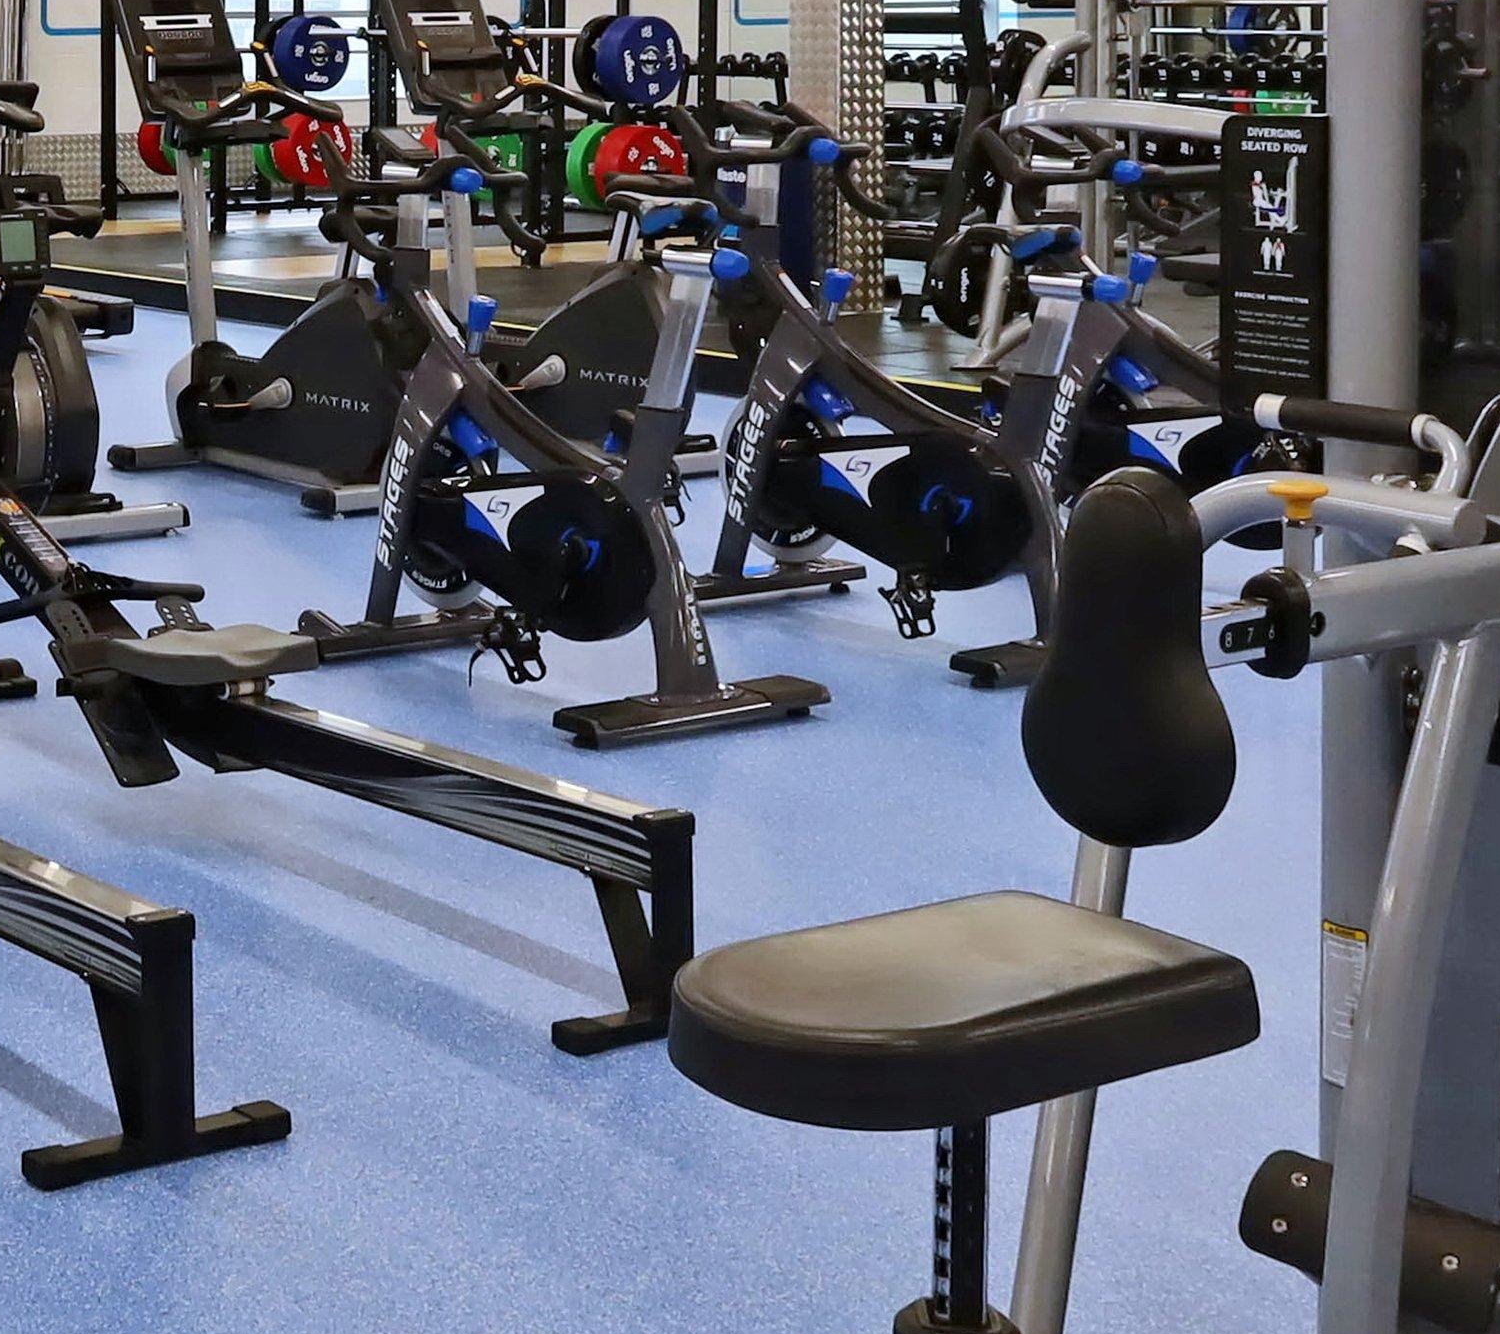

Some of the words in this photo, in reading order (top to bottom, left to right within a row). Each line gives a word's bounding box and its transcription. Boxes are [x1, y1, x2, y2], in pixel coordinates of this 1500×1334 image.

[1247, 126, 1302, 139] DIVERGING
[1241, 140, 1281, 153] SEATED
[1283, 142, 1308, 154] ROW
[579, 367, 649, 389] MATRIX
[305, 390, 371, 414] MATRIX
[1039, 373, 1079, 490] STAGES
[727, 400, 767, 526] STAGES
[376, 434, 411, 570] STAGES
[1225, 631, 1233, 648] 8
[1247, 626, 1255, 643] 7
